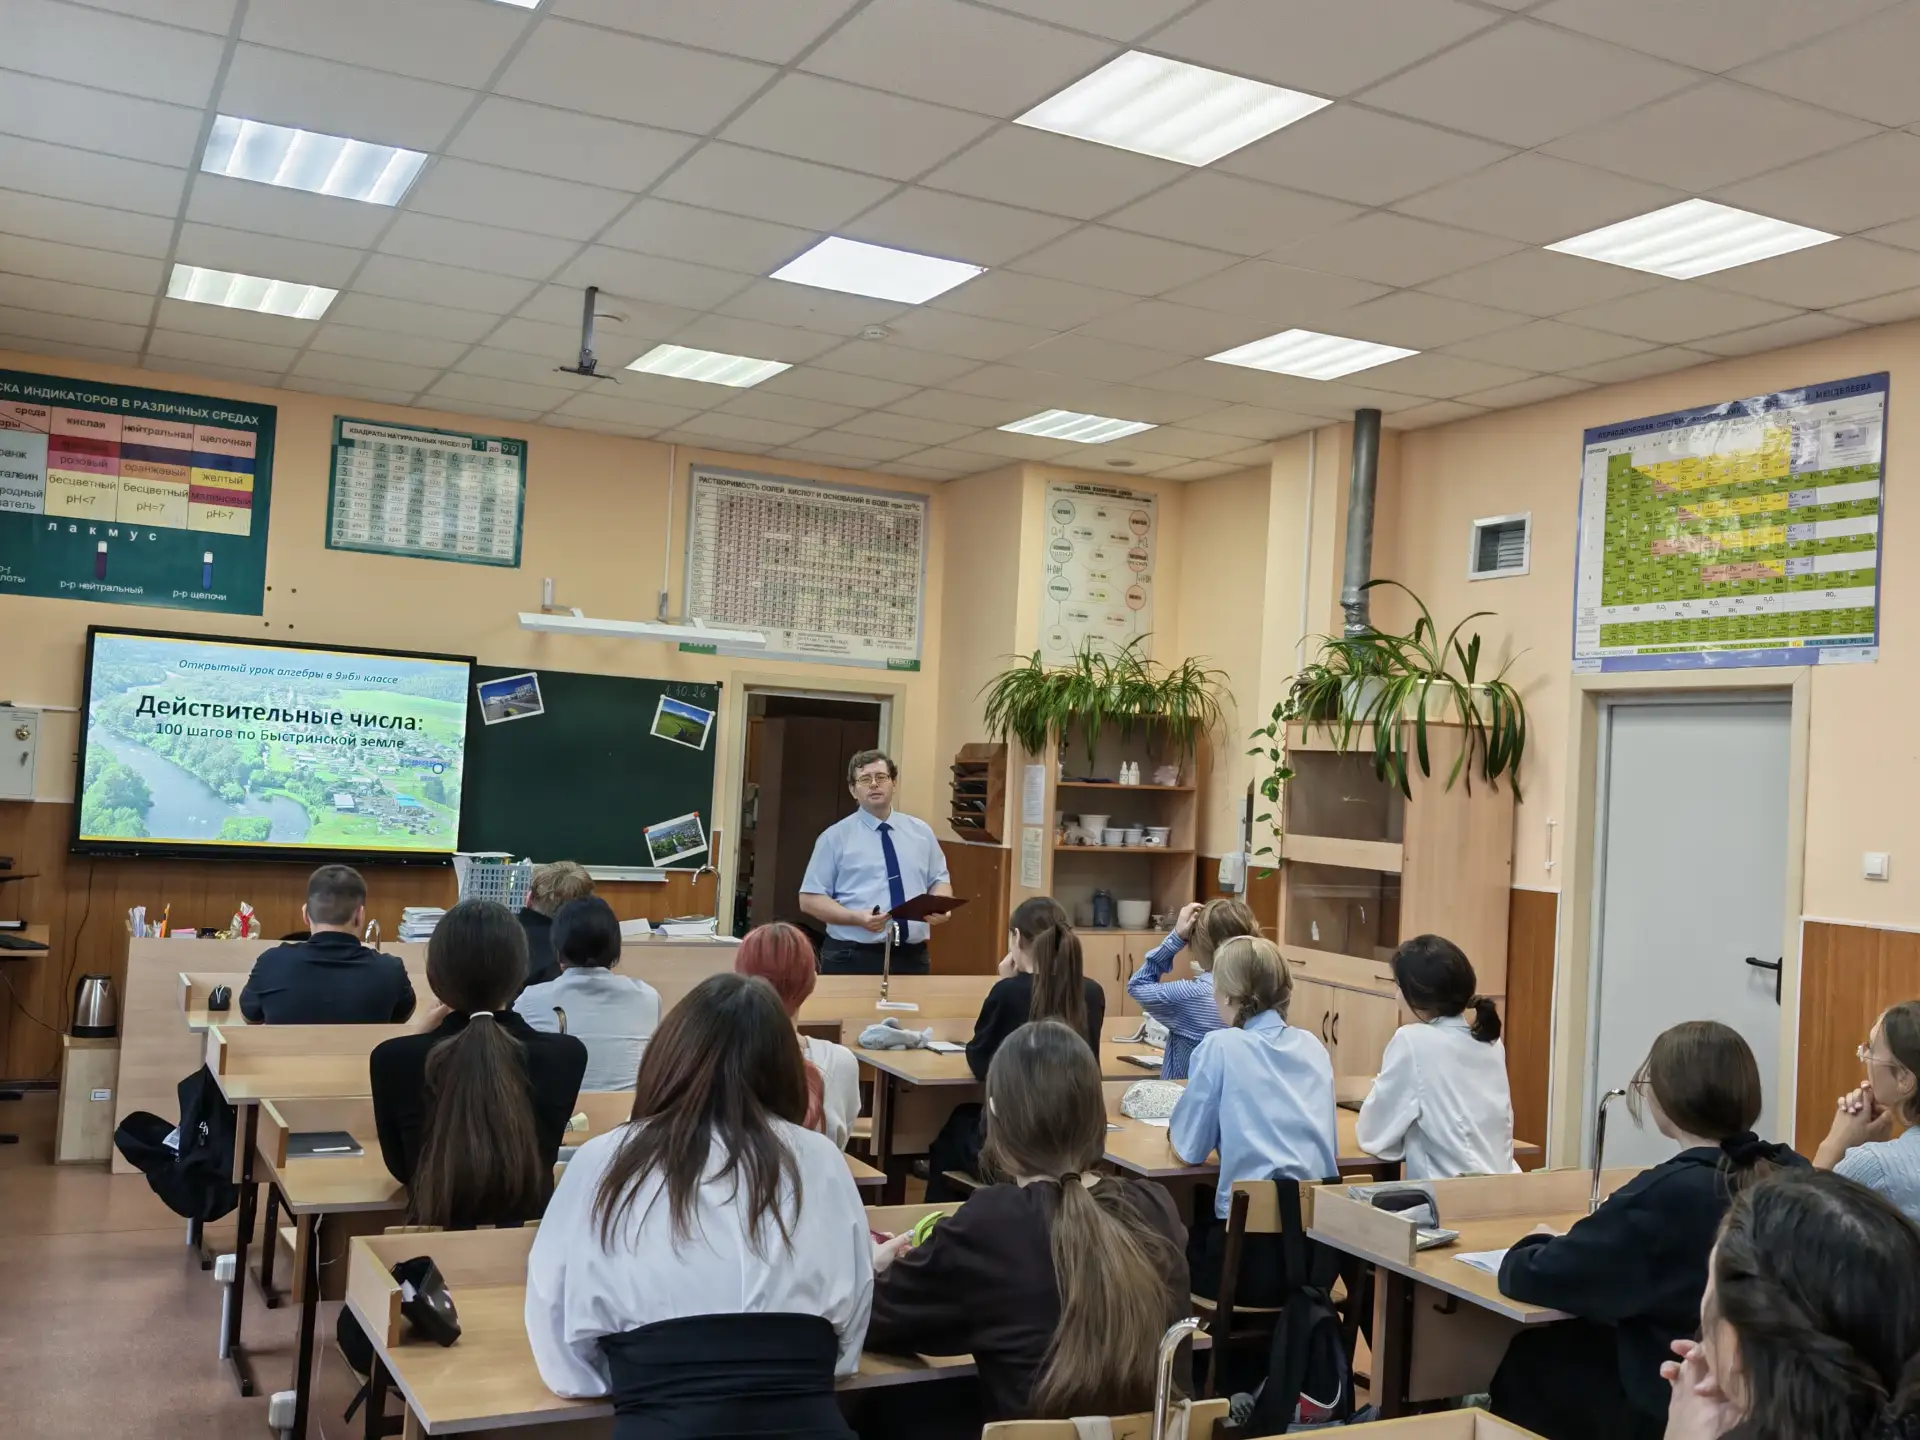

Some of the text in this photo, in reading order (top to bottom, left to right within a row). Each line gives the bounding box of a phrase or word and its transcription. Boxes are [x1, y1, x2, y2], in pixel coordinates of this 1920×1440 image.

[1816, 382, 1872, 399] МЕНДЕЛЕЕВА
[15, 407, 47, 418] среда
[23, 385, 118, 407] ИНДИКАТОРОВ
[122, 399, 130, 408] В
[133, 400, 210, 419] РАЗЛИЧНЫХ
[212, 410, 260, 426] СРЕДАХ
[66, 417, 106, 430] кислая
[124, 423, 193, 440] нейтральная
[1598, 423, 1654, 439] ПЕРИОДИЧЕСКАЯ
[200, 434, 252, 449] щелочная
[349, 428, 387, 439] КВАДРАТЫ
[387, 432, 437, 446] НАТУРАЛЬНЫХ
[472, 440, 486, 451] 11
[502, 444, 518, 456] 99
[60, 454, 109, 470] розовый
[124, 463, 187, 478] оранжевый
[48, 474, 117, 491] бесцветный
[202, 472, 244, 487] желтый
[123, 482, 189, 499] бесцветный
[698, 476, 760, 491] РАСТВОРИМОСТЬ
[788, 488, 815, 498] КИСЛОТ
[823, 492, 865, 504] ОСНОВАНИЙ
[872, 498, 890, 507] ВОДЕ
[78, 581, 144, 596] нейтральный
[190, 591, 227, 602] щелочи
[178, 659, 247, 674] Открытый
[248, 666, 275, 676] урок
[277, 667, 324, 680] алгебры
[363, 675, 399, 684] классе
[135, 694, 424, 731] Действительные числа:
[155, 722, 405, 749] 100 шагов по Быстринской земле
